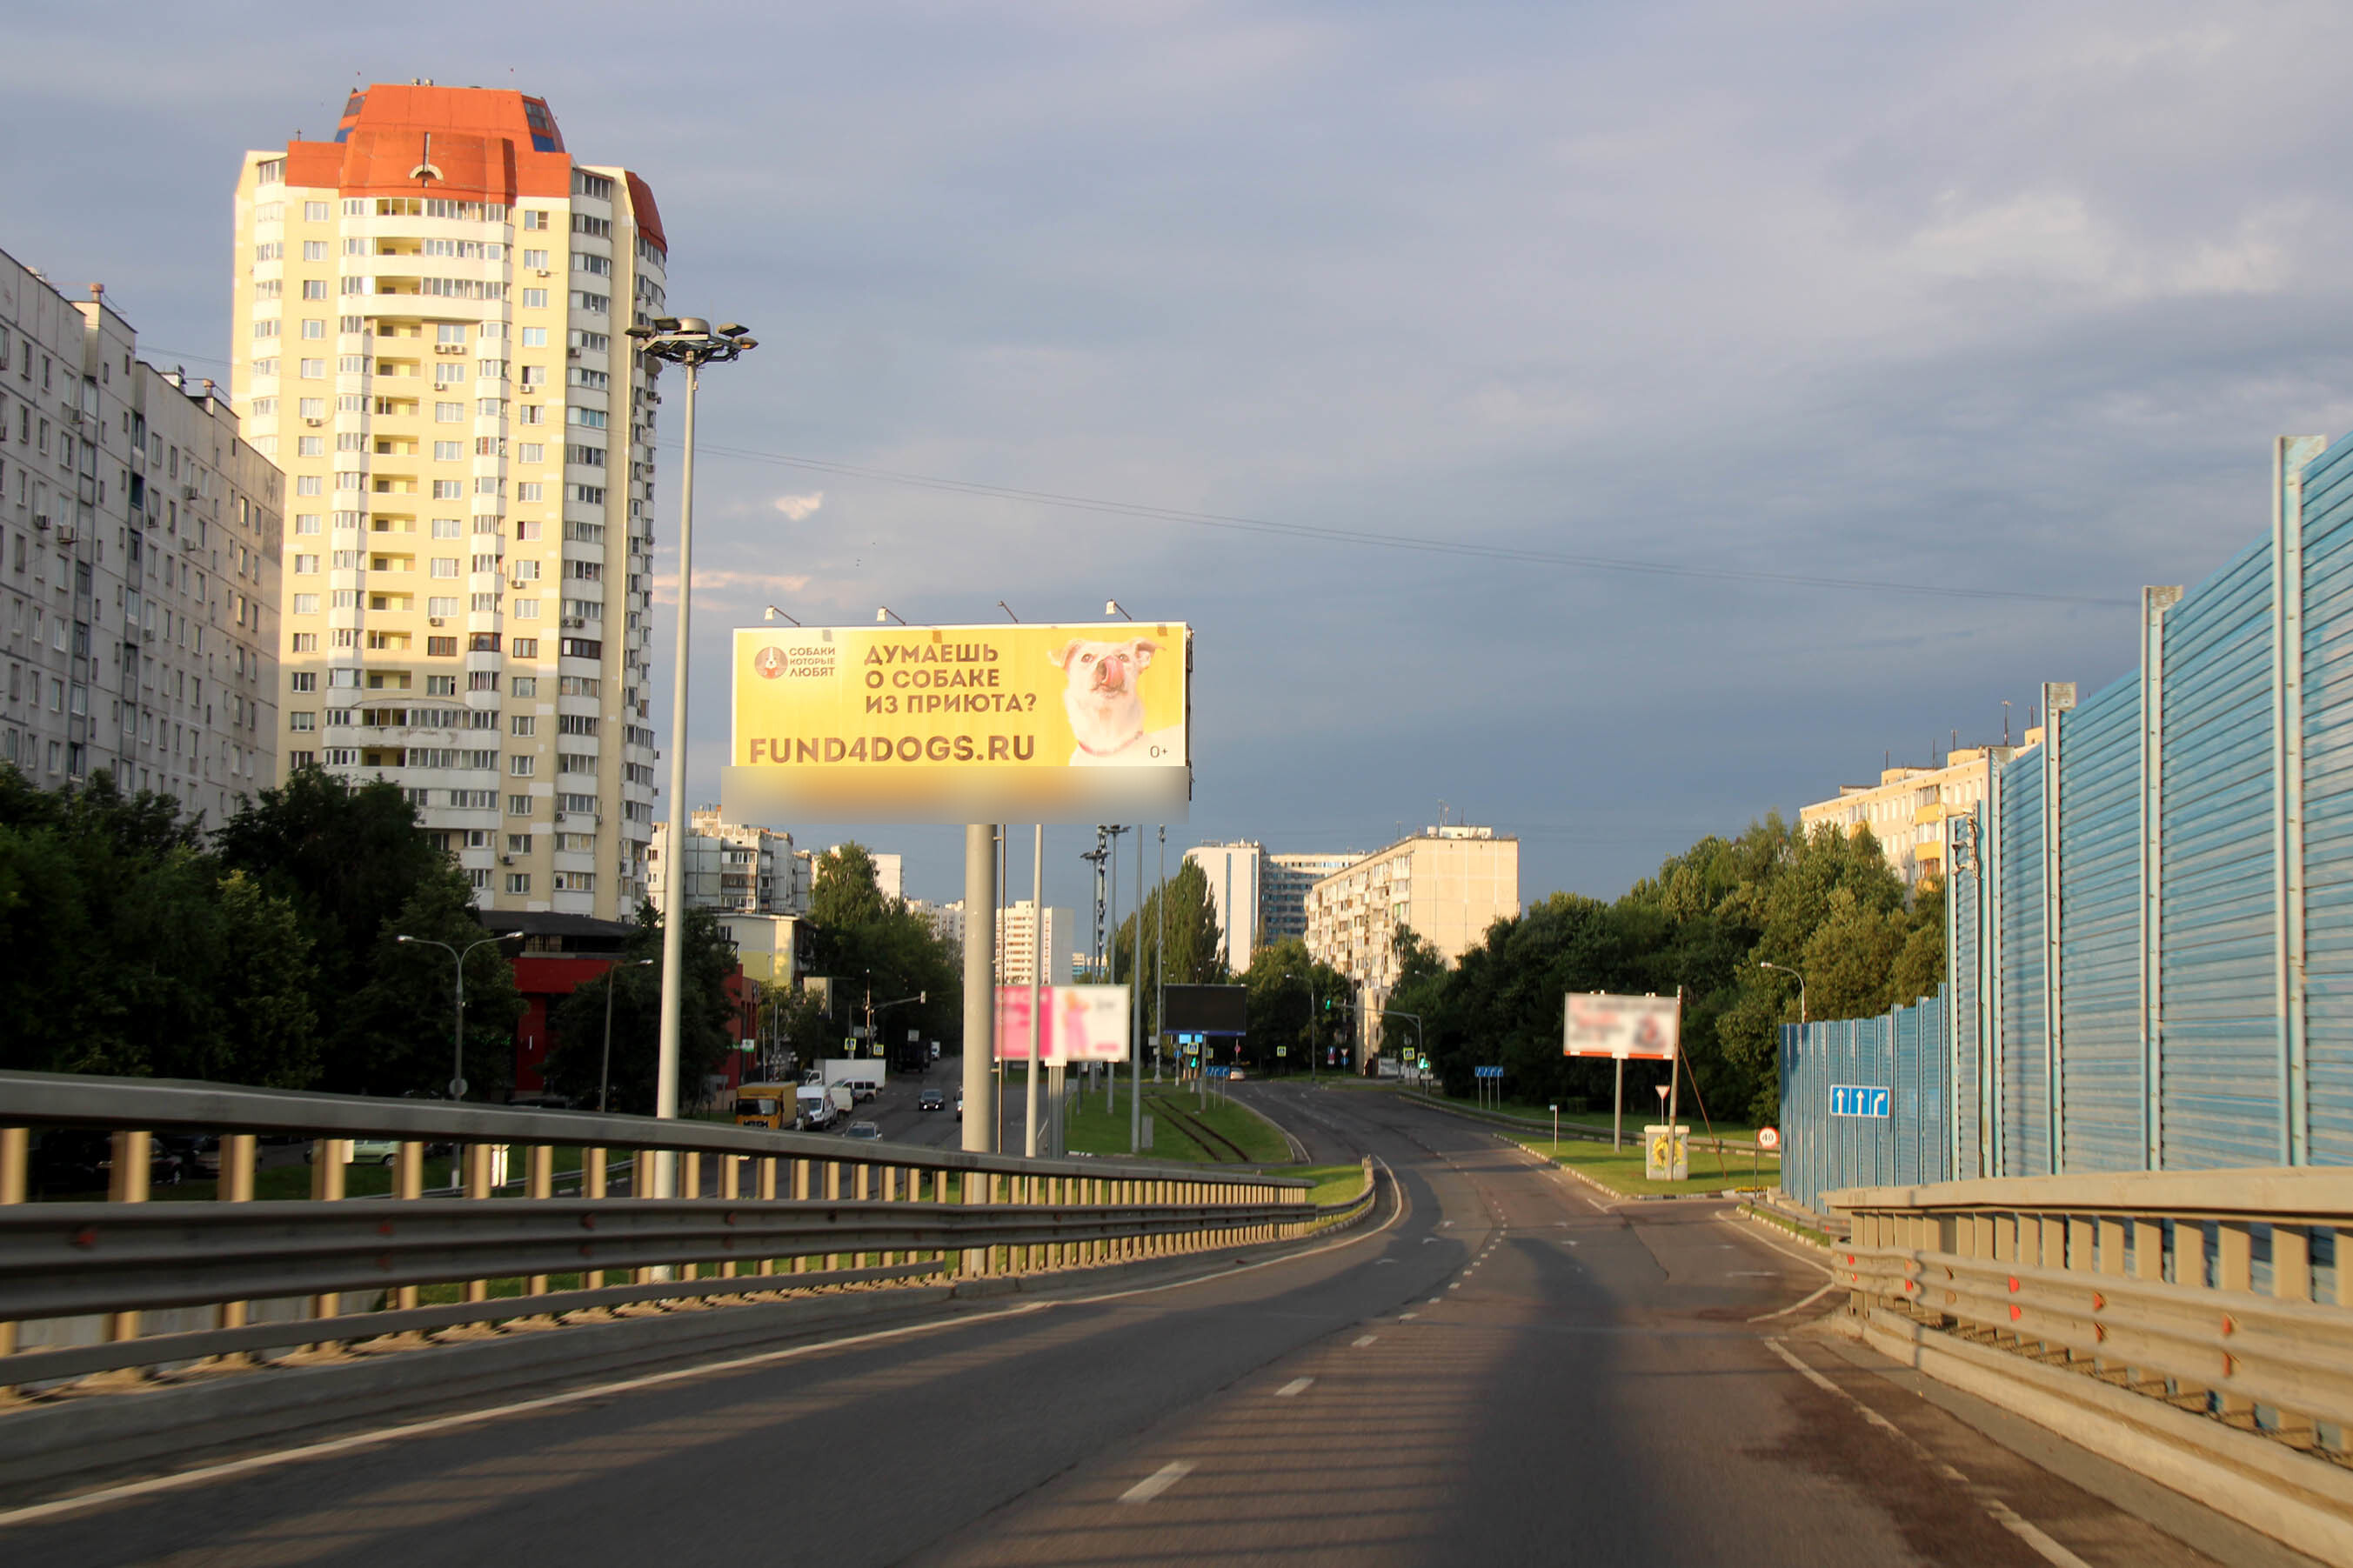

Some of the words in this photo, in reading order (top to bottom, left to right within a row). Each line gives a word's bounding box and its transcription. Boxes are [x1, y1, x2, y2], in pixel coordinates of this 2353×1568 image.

[789, 647, 835, 656] СОБАКИ
[864, 644, 999, 666] ДУМАЕШЬ
[789, 667, 835, 677] ЛЮБЯТ
[865, 670, 885, 689] О
[892, 669, 999, 689] СОБАКЕ
[866, 695, 899, 714] ИЗ
[907, 692, 1037, 714] ПРИЮТА?
[750, 735, 1035, 764] FUND4DOGS.RU
[1150, 745, 1168, 758] 0+
[1761, 1133, 1774, 1142] 40
